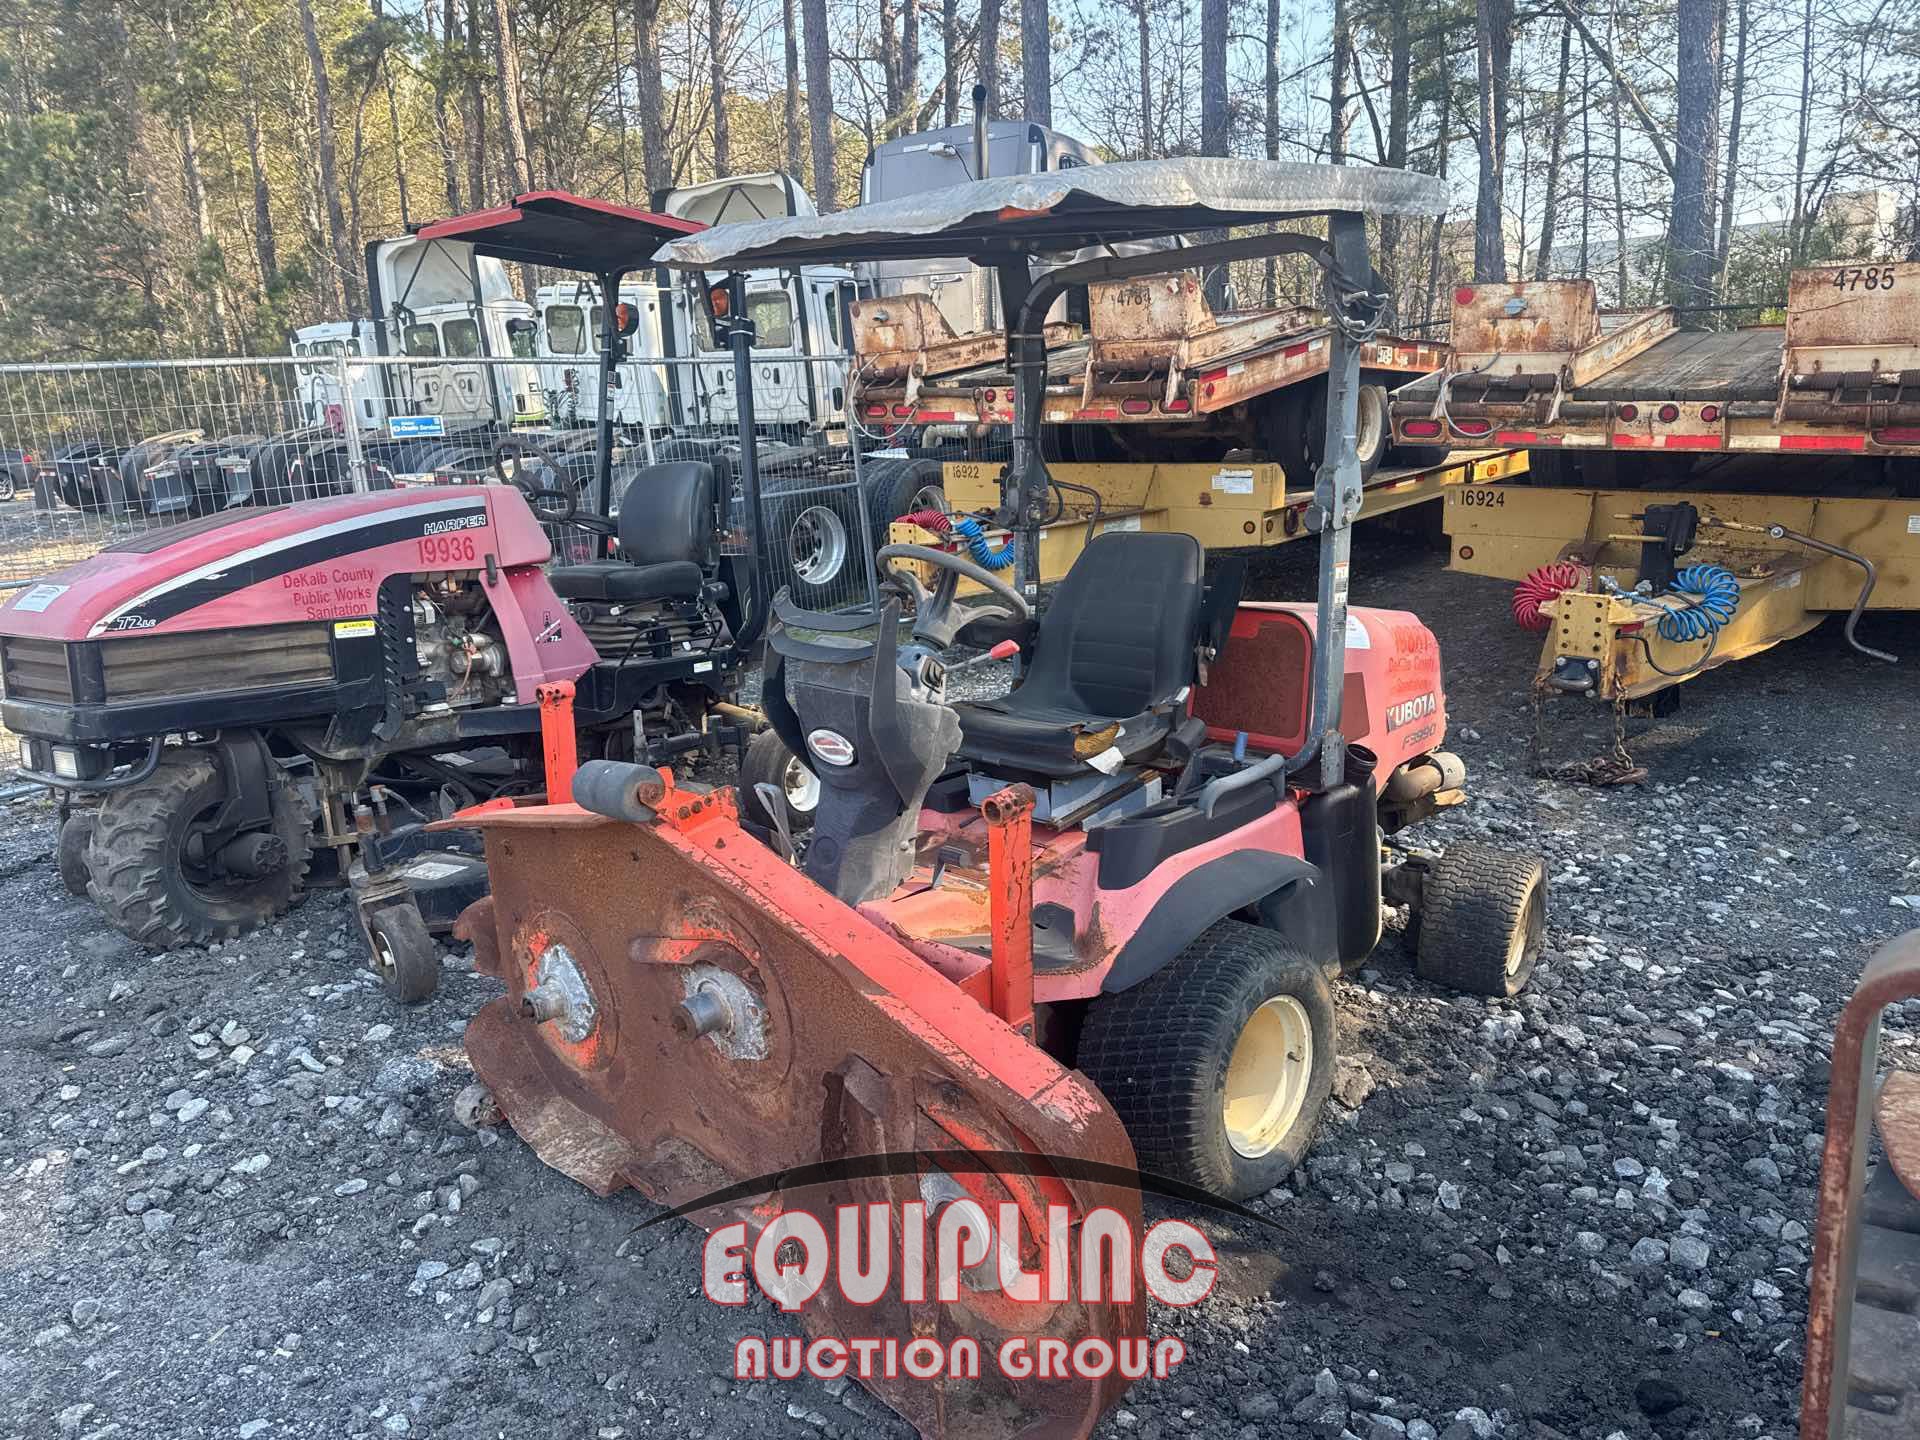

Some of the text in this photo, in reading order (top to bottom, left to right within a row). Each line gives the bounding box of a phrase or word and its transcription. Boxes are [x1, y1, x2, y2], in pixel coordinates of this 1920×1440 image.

[1832, 267, 1895, 291] 4785
[952, 465, 979, 478] 16922
[1461, 490, 1504, 507] 16924
[424, 514, 486, 535] HARPER
[417, 536, 475, 564] 19936
[283, 568, 374, 589] DeKalb County
[293, 586, 372, 606] Public Works
[306, 602, 368, 620] Sanitation
[1387, 692, 1436, 732] KUBOTA
